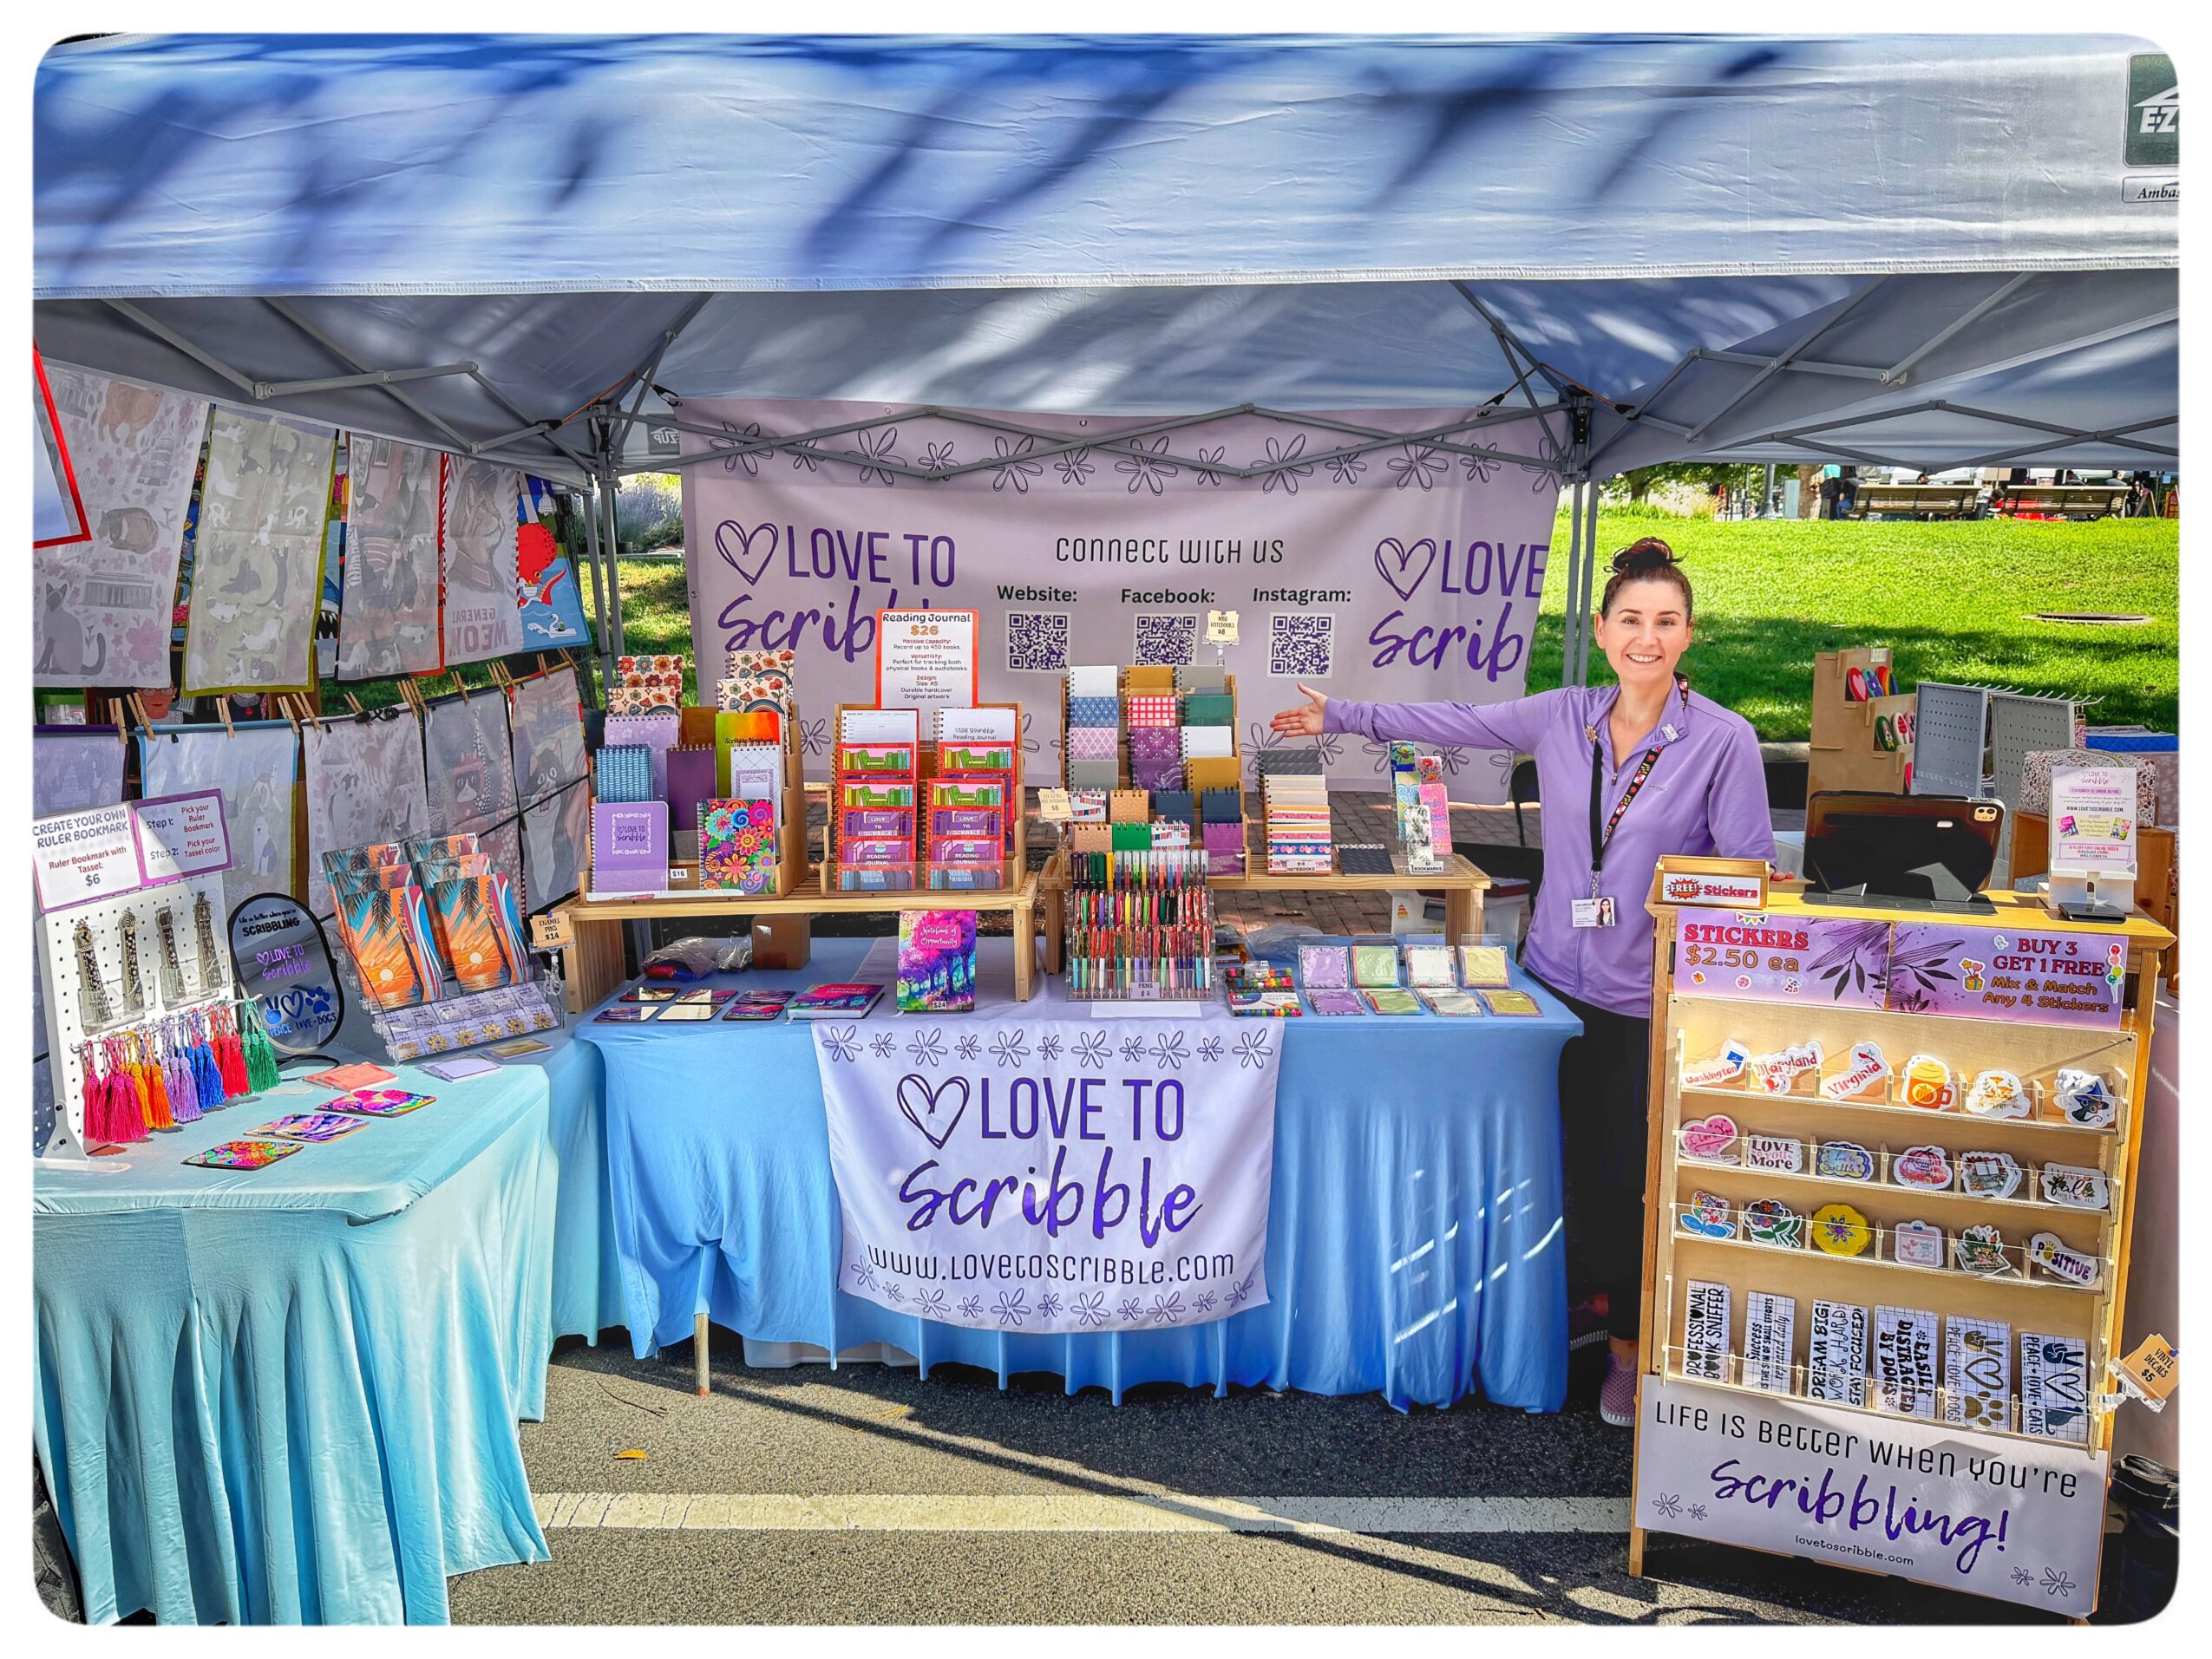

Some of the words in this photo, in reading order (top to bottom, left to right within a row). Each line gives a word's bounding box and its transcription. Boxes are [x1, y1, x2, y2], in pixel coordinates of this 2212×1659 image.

[787, 524, 892, 585] LOVE
[903, 533, 956, 588] TO
[1441, 539, 1549, 598] LOVE
[997, 585, 1078, 604] Website:
[1121, 587, 1215, 604] Facebook:
[1253, 586, 1351, 606] Instagram:
[882, 613, 926, 624] Reading
[928, 613, 971, 623] Journal
[911, 624, 939, 636] $26
[1369, 601, 1524, 683] Scrib
[180, 806, 195, 815] Pick
[195, 804, 210, 815] your
[188, 814, 206, 823] Ruler
[32, 819, 74, 837] CREATE
[75, 813, 102, 828] YOUR
[103, 809, 127, 822] OWN
[37, 833, 72, 848] RULER
[75, 821, 129, 841] BOOKMARK
[147, 819, 167, 830] Step
[168, 818, 174, 828] 1:
[183, 821, 215, 833] Bookmark
[150, 849, 171, 860] Step
[172, 846, 180, 857] 2:
[184, 847, 204, 859] Tassel
[204, 846, 221, 856] color
[187, 839, 200, 848] Pick
[201, 837, 216, 848] your
[49, 858, 70, 870] Ruler
[72, 849, 110, 865] Bookmark
[110, 846, 128, 857] with
[77, 862, 104, 874] Tassel:
[86, 873, 101, 887] $6
[1670, 883, 1698, 893] FREE!
[1704, 885, 1758, 898] Stickers
[242, 917, 300, 937] SCRIBBLING
[539, 918, 561, 926] ENAMEL
[920, 925, 949, 937] Notebook
[951, 925, 958, 937] of
[920, 937, 958, 947] Opportunity
[1685, 924, 1810, 949] STICKERS
[2017, 938, 2062, 954] BUY
[2065, 941, 2078, 956] 3
[270, 946, 293, 963] LOVE
[293, 944, 304, 956] TO
[1685, 944, 1758, 969] $2.50
[1768, 956, 1799, 972] ea
[1993, 955, 2036, 972] GET
[2039, 958, 2047, 973] 1
[2052, 959, 2105, 976] FREE
[262, 957, 312, 982] Scribble
[1991, 976, 2021, 990] Mix
[2025, 978, 2039, 991] &
[2043, 979, 2097, 996] Match
[1982, 991, 2017, 1008] Any
[2021, 994, 2033, 1006] 4
[2037, 996, 2109, 1012] Stickers
[268, 1023, 292, 1037] PEACE
[295, 1019, 313, 1030] LOVE
[317, 1013, 337, 1025] DOGS
[1685, 1065, 1738, 1084] Washington
[1754, 1050, 1817, 1077] Maryland
[1827, 1061, 1884, 1095] Virginia
[981, 1077, 1106, 1141] LOVE
[1122, 1078, 1184, 1142] TO
[1751, 1140, 1795, 1153] LOVE
[1751, 1153, 1793, 1170] More
[899, 1145, 1203, 1249] Scribble
[1706, 1288, 1724, 1338] SNIFFER
[1765, 1297, 1774, 1323] EFFORTS
[1764, 1323, 1772, 1344] SMALL
[1778, 1316, 1790, 1339] daily
[1745, 1323, 1763, 1363] Success
[1879, 1331, 1895, 1353] BY
[1947, 1326, 1961, 1359] PEACE
[2025, 1336, 2040, 1368] PEACE
[1775, 1338, 1787, 1380] repeated
[1811, 1340, 1828, 1400] DREAM
[1896, 1319, 1916, 1413] DISTRACTED
[1914, 1342, 1933, 1397] EASILY
[2144, 1354, 2169, 1378] DECALS
[2155, 1348, 2175, 1368] VINYL
[1829, 1358, 1848, 1401] WORK
[1880, 1355, 1898, 1396] DOGS
[1947, 1362, 1961, 1388] LOVE
[2142, 1368, 2156, 1382] $5
[1849, 1373, 1862, 1406] STAY
[2027, 1375, 2042, 1400] LOVE
[1947, 1395, 1961, 1423] DOGS
[2028, 1404, 2043, 1435] CATS
[1711, 1459, 2009, 1575] Scribbling!
[1795, 1534, 1914, 1566] lovetoscribble.com
